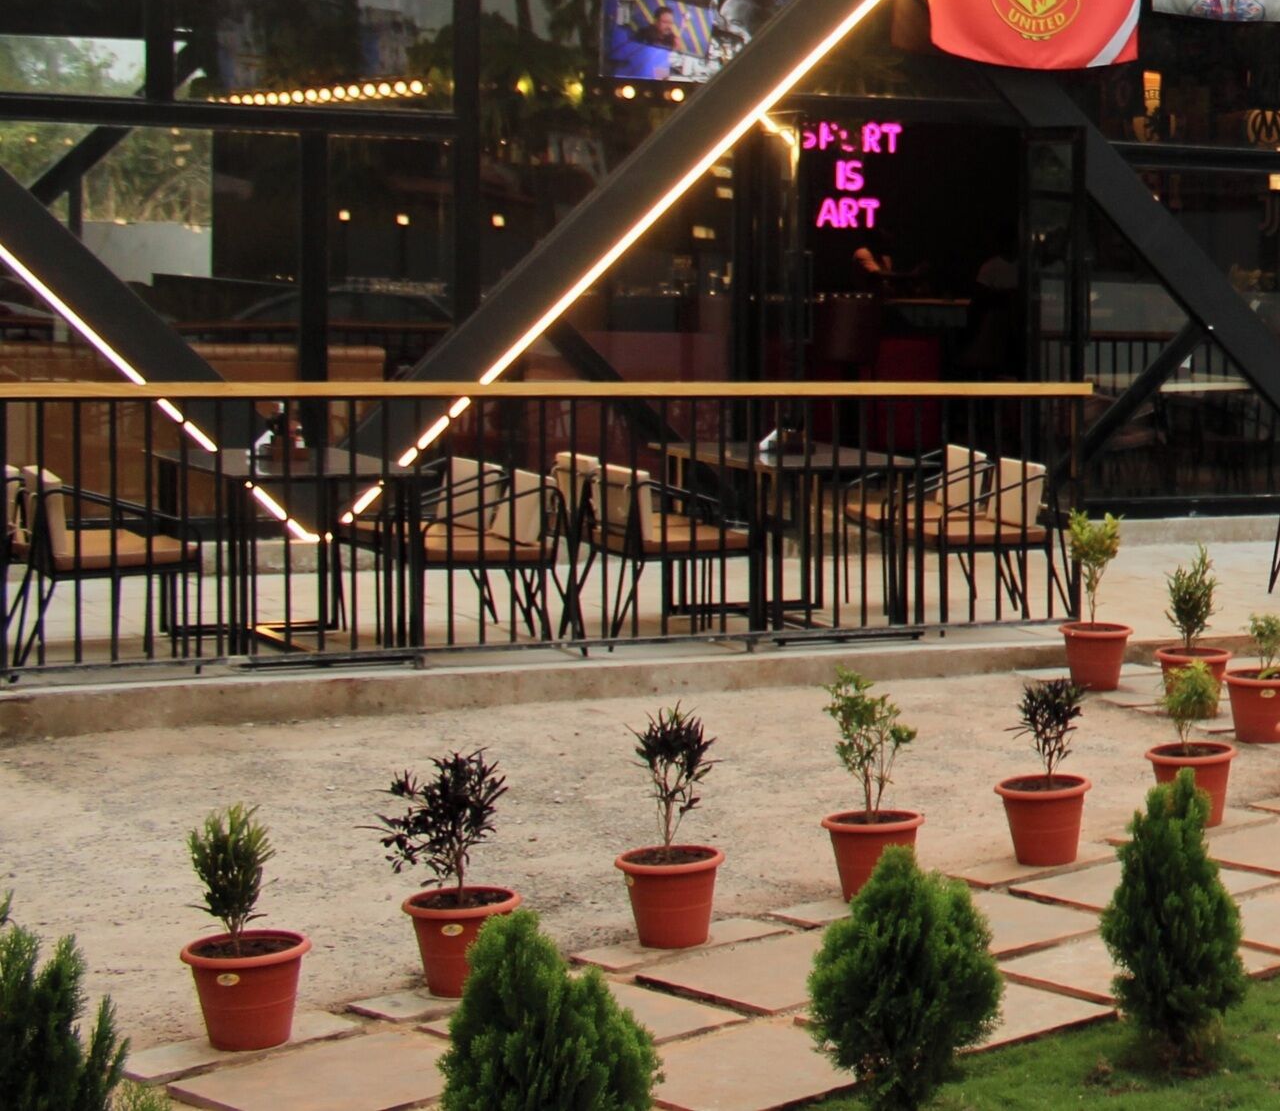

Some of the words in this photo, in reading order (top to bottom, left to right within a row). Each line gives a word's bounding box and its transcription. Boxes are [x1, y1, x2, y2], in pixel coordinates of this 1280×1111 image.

[1008, 8, 1066, 32] UNITED
[835, 159, 865, 191] IS
[816, 196, 881, 229] ART
